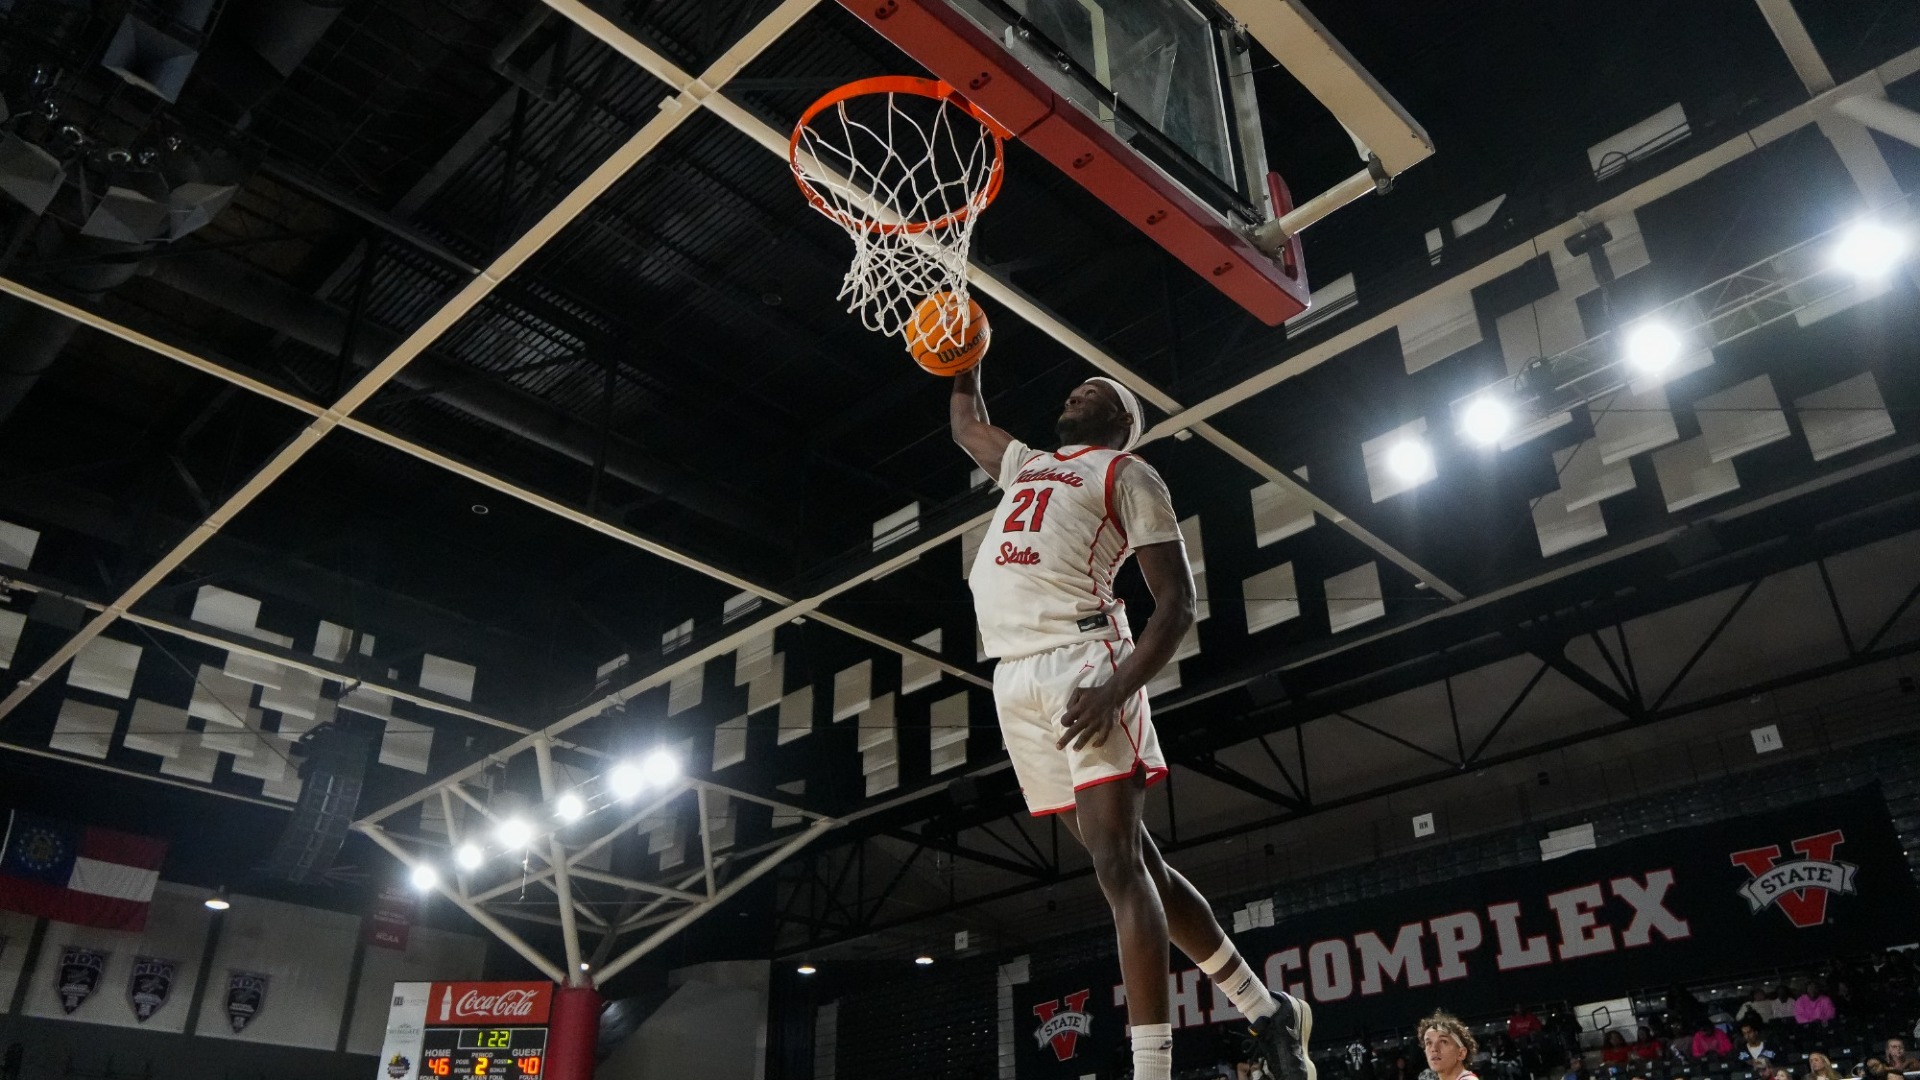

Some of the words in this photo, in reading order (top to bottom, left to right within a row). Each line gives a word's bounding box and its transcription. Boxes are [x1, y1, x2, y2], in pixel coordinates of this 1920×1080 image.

[936, 326, 988, 364] Wilson
[1003, 487, 1054, 533] 21
[995, 541, 1041, 566] State
[1761, 866, 1833, 895] STATE
[1264, 868, 1690, 1004] COMPLEX
[62, 952, 103, 970] NDA
[135, 963, 175, 980] NDA
[229, 975, 263, 991] NDA
[456, 989, 539, 1017] Coca-Cola
[1045, 1015, 1082, 1036] STATE
[424, 1049, 452, 1057] HOME
[428, 1057, 451, 1076] 46
[474, 1057, 489, 1075] 2
[517, 1057, 541, 1075] 40
